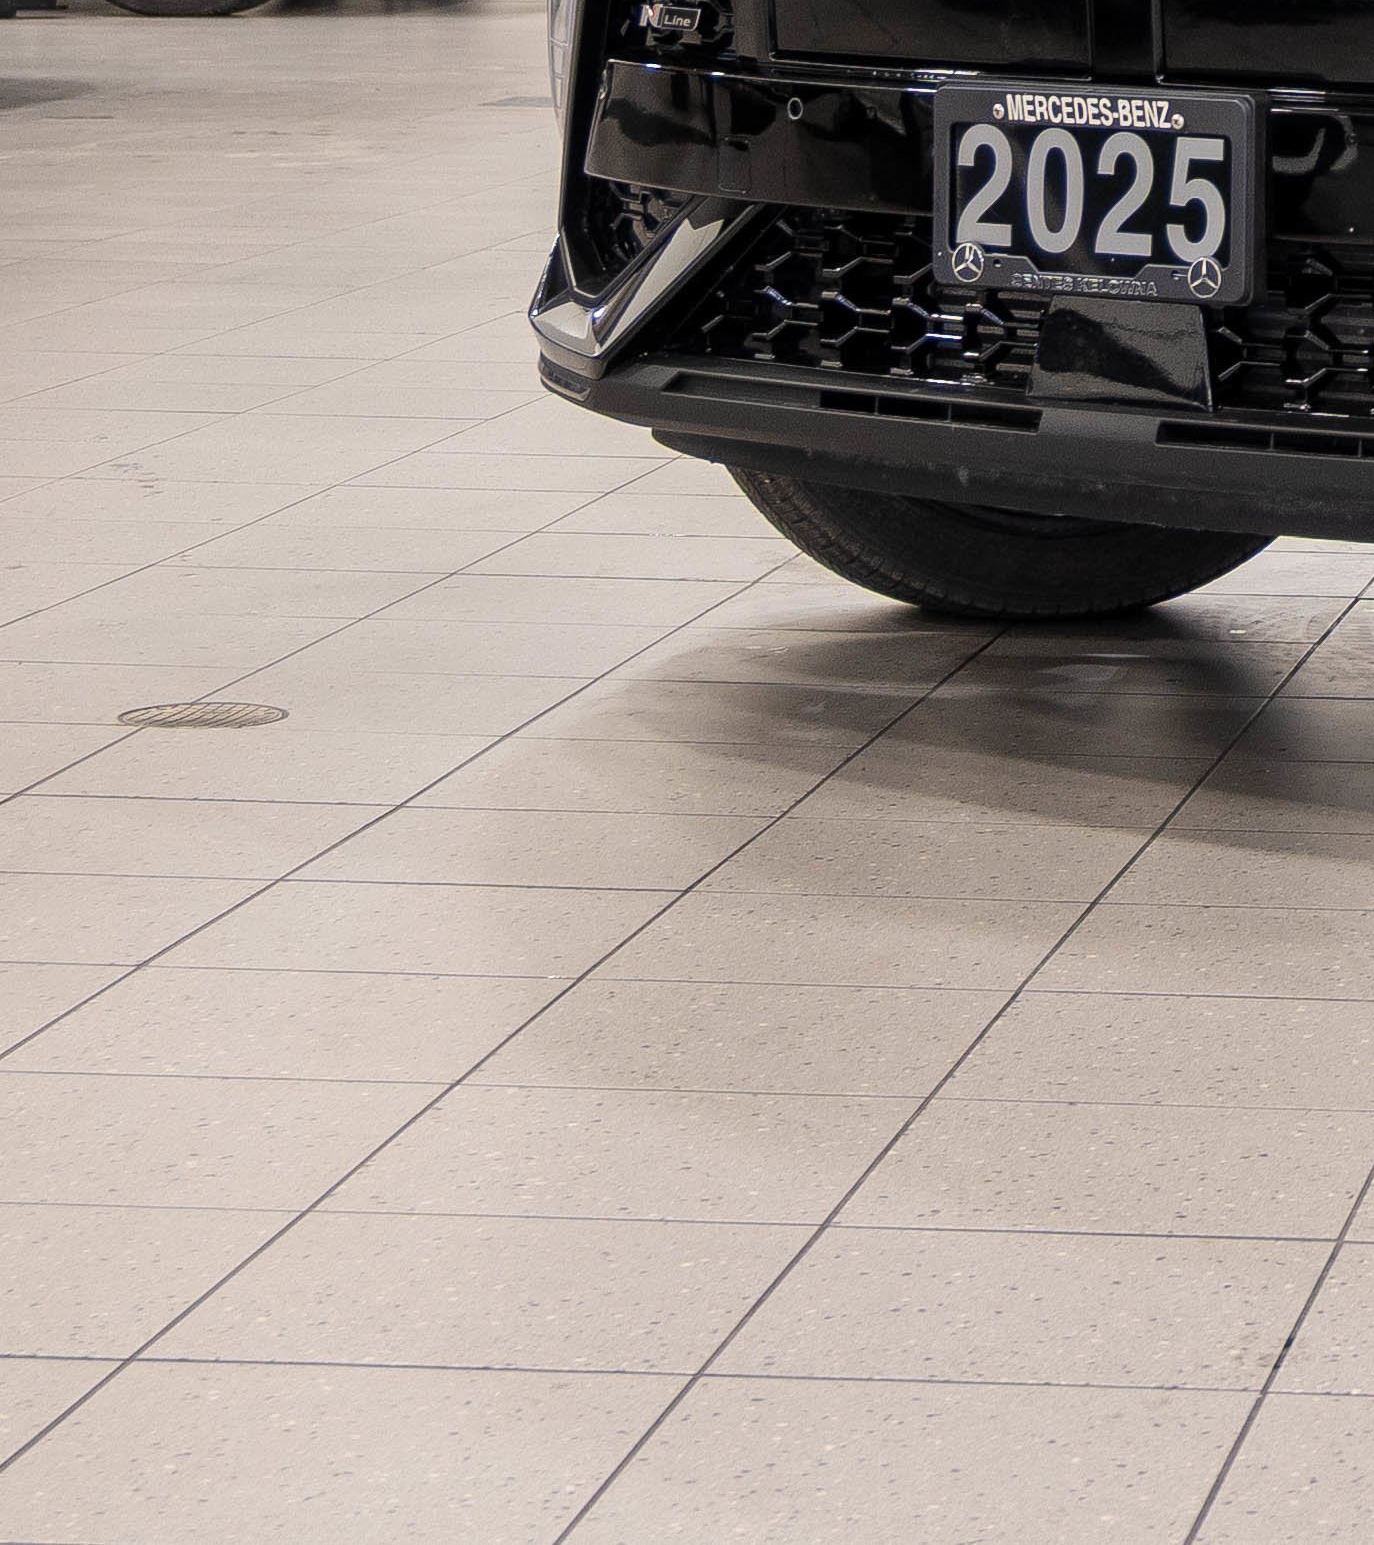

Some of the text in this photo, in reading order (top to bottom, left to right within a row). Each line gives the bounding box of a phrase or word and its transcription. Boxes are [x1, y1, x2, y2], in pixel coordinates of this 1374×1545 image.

[664, 15, 692, 27] Line
[1005, 93, 1172, 129] MERCEDES-BENZ
[956, 123, 1226, 264] 2025
